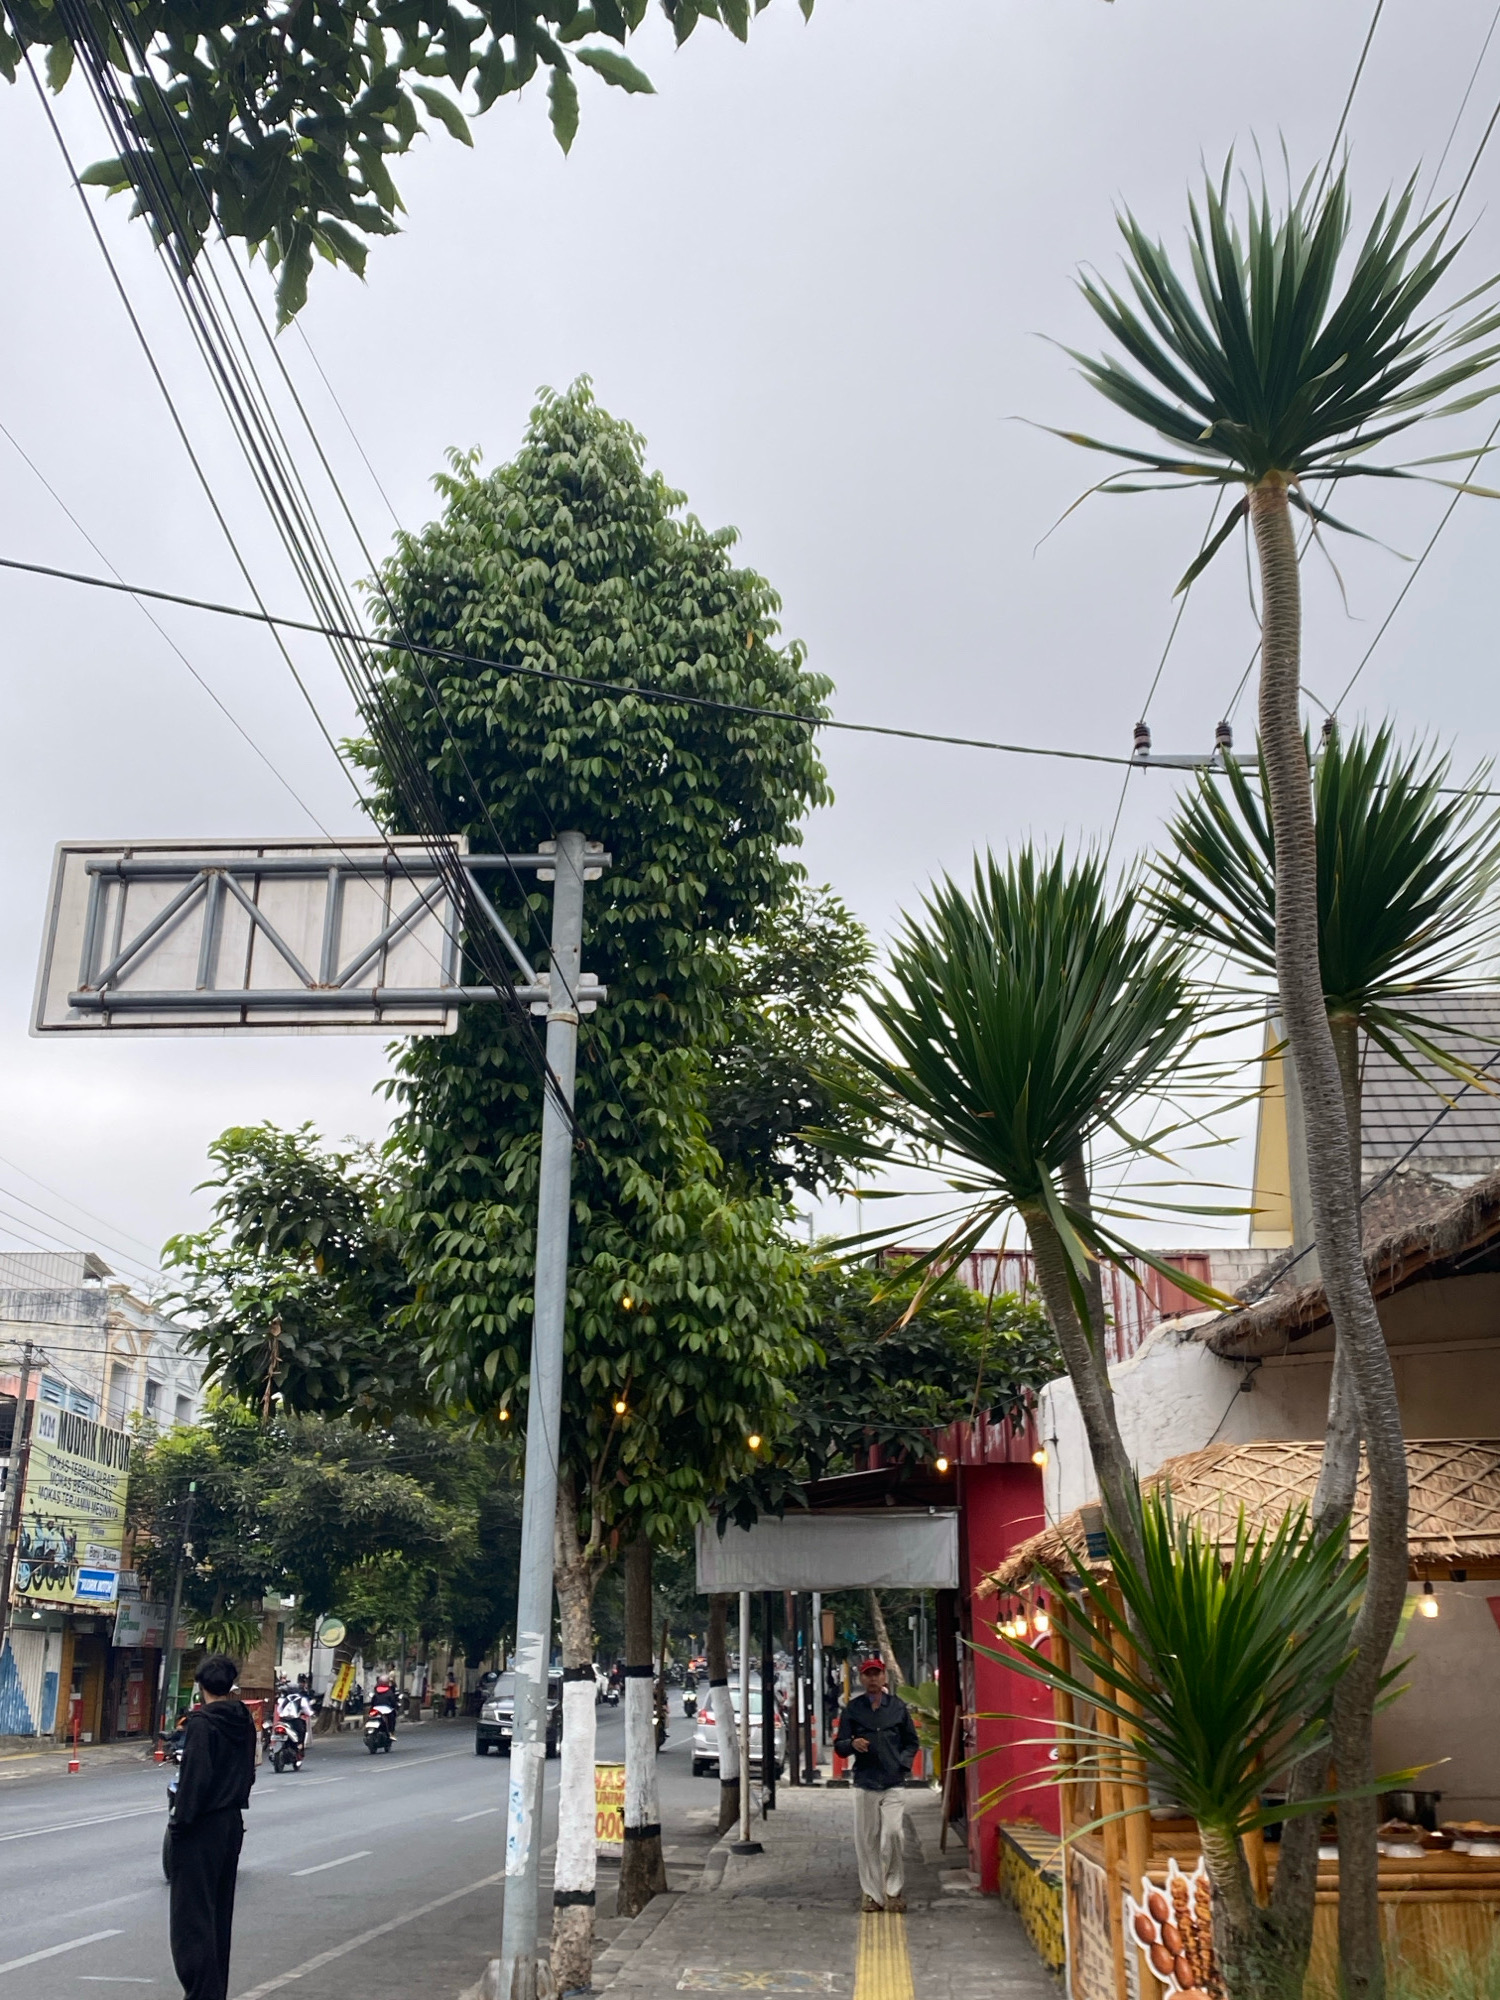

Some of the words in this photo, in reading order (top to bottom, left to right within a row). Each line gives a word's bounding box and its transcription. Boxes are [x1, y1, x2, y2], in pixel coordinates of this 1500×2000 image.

[39, 1412, 56, 1438] MM
[57, 1410, 98, 1462] MUDRIK
[98, 1426, 131, 1473] MOTOR
[47, 1454, 70, 1473] MOKAS
[50, 1471, 72, 1491] MOKAS
[38, 1485, 61, 1504] MOKAS
[62, 1492, 91, 1513] TERJAMIN
